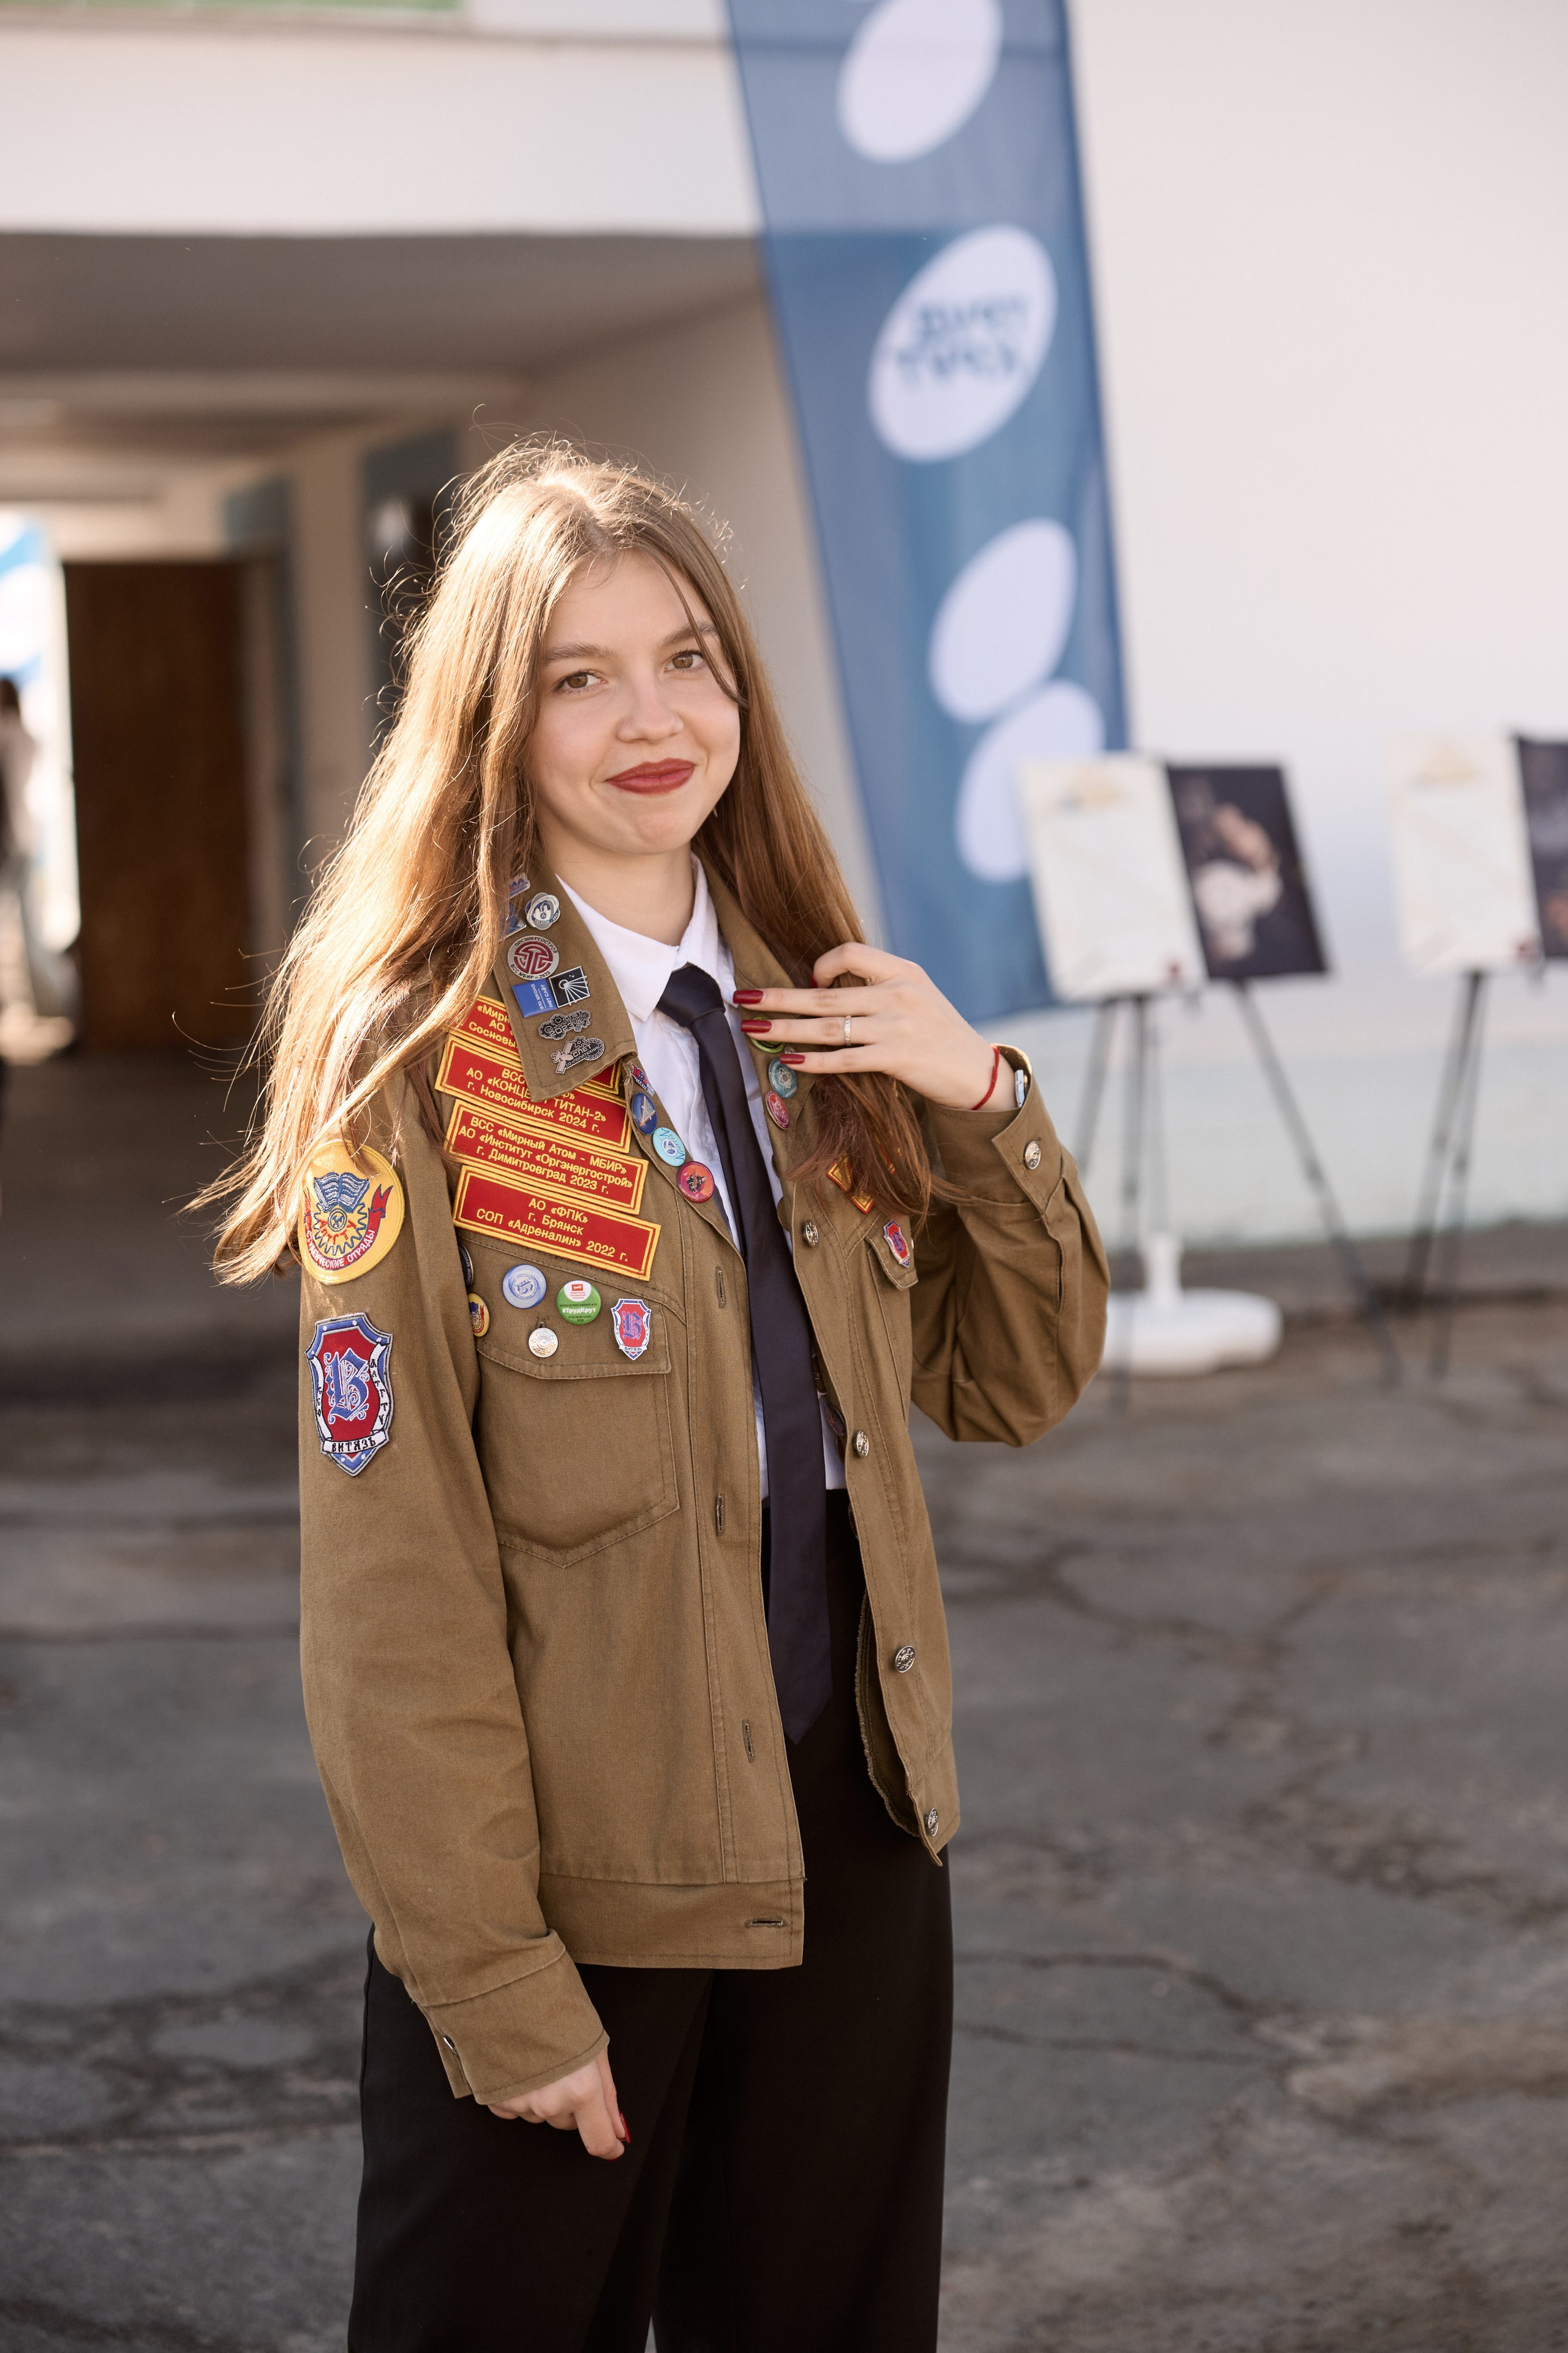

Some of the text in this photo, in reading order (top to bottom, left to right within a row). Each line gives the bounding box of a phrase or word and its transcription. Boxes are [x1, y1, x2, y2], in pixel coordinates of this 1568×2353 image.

[514, 937, 558, 954] ОРГЭНЕРГОСТРОЙ
[510, 964, 519, 973] ВСС
[478, 1005, 509, 1024] «Мирн
[489, 1019, 505, 1032] АО
[469, 1021, 518, 1048] Сосновы
[549, 1022, 575, 1037] 2023
[573, 1043, 592, 1058] СЛЕТ
[502, 1068, 525, 1084] ВСС
[466, 1067, 606, 1122] АО «КОНЦЕ ТИТАН-2»
[467, 1081, 475, 1090] г.
[480, 1084, 554, 1118] Новосибирск
[559, 1112, 587, 1128] 2024
[592, 1124, 600, 1133] г.
[458, 1125, 633, 1188] АО «Институт «Оргэнергострой»
[470, 1116, 494, 1132] ВСС
[498, 1128, 545, 1150] «Мирный
[548, 1144, 576, 1160] Атом
[590, 1155, 627, 1174] МБИР»
[477, 1146, 609, 1195] г. Димитровград 2023 г.
[529, 1198, 588, 1223] АО «ФПК»
[477, 1208, 628, 1262] СОП «Адреналин» 2022 г.
[528, 1212, 584, 1235] г. Брянск
[347, 1229, 375, 1262] ОТРЯДЫ
[331, 1437, 376, 1452] ВИТЯЗЬ
